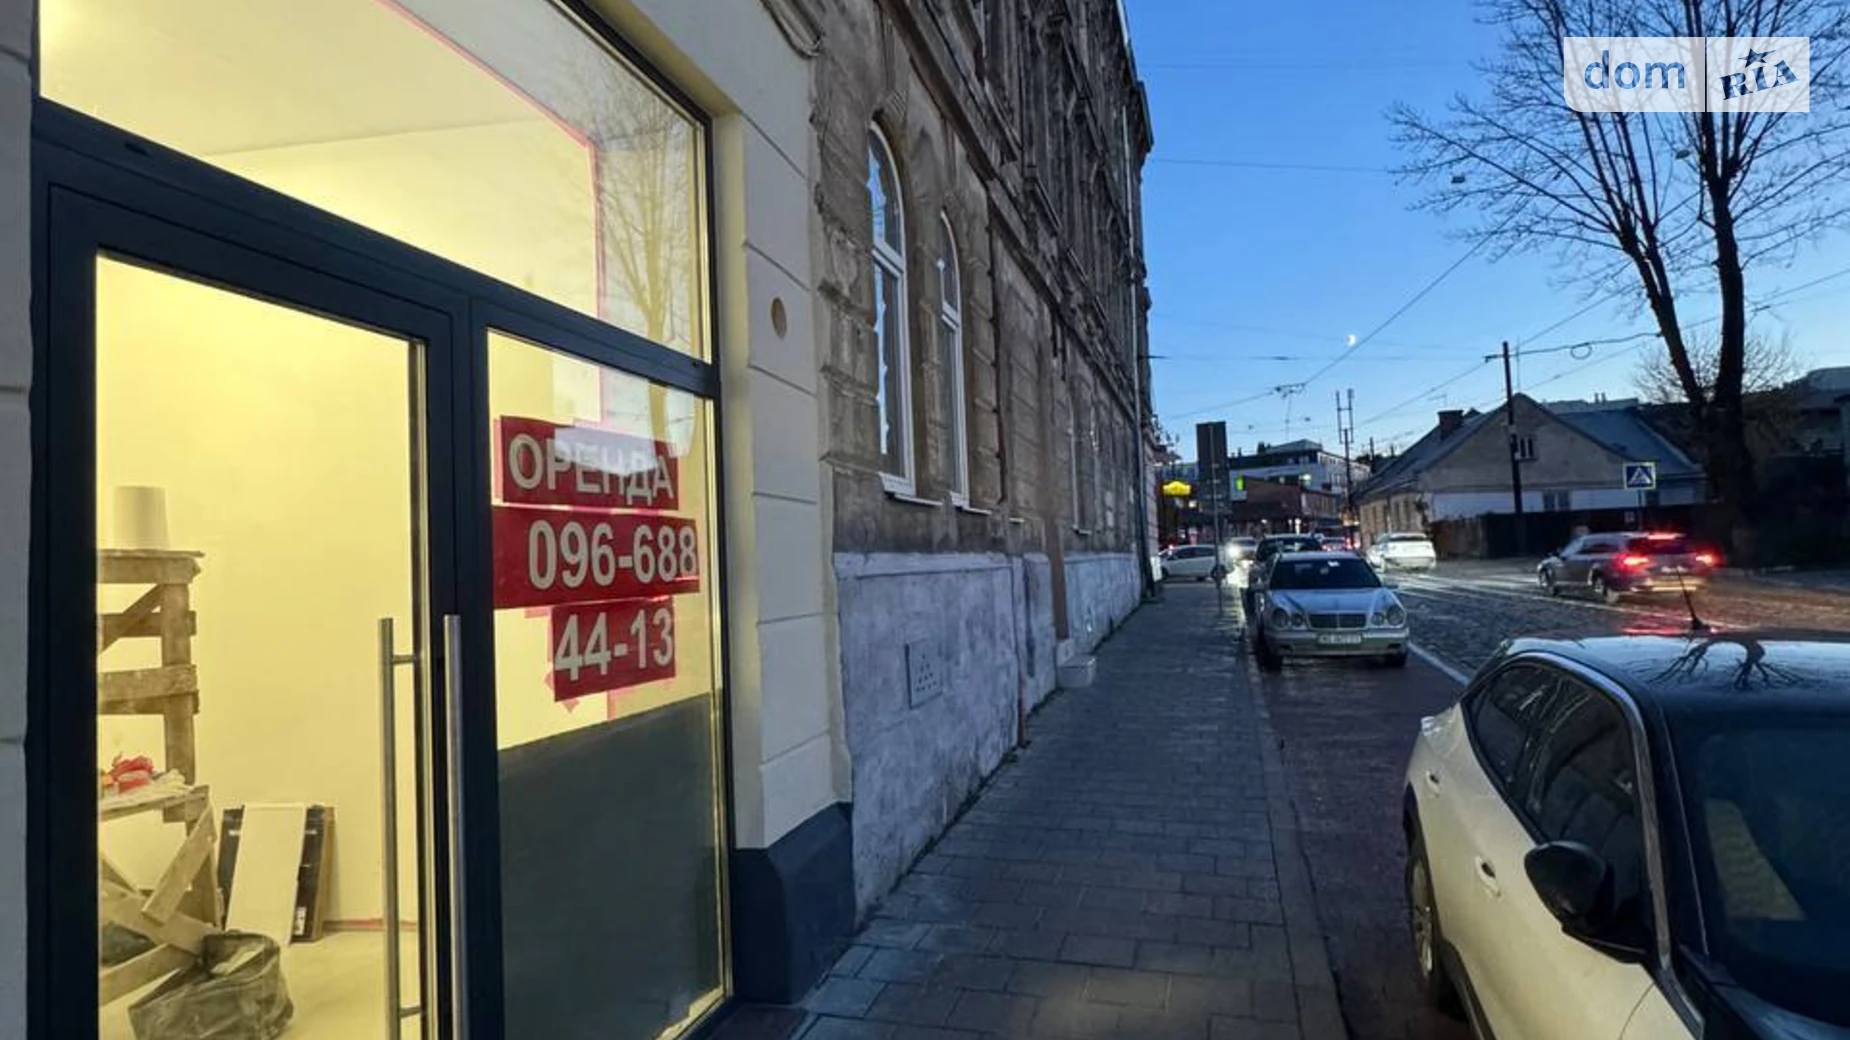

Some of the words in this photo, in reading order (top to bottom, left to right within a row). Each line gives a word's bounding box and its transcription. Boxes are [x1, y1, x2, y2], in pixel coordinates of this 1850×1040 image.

[508, 433, 675, 505] ОРЕНДА
[528, 519, 698, 590] 096-688
[555, 608, 674, 681] 44-13
